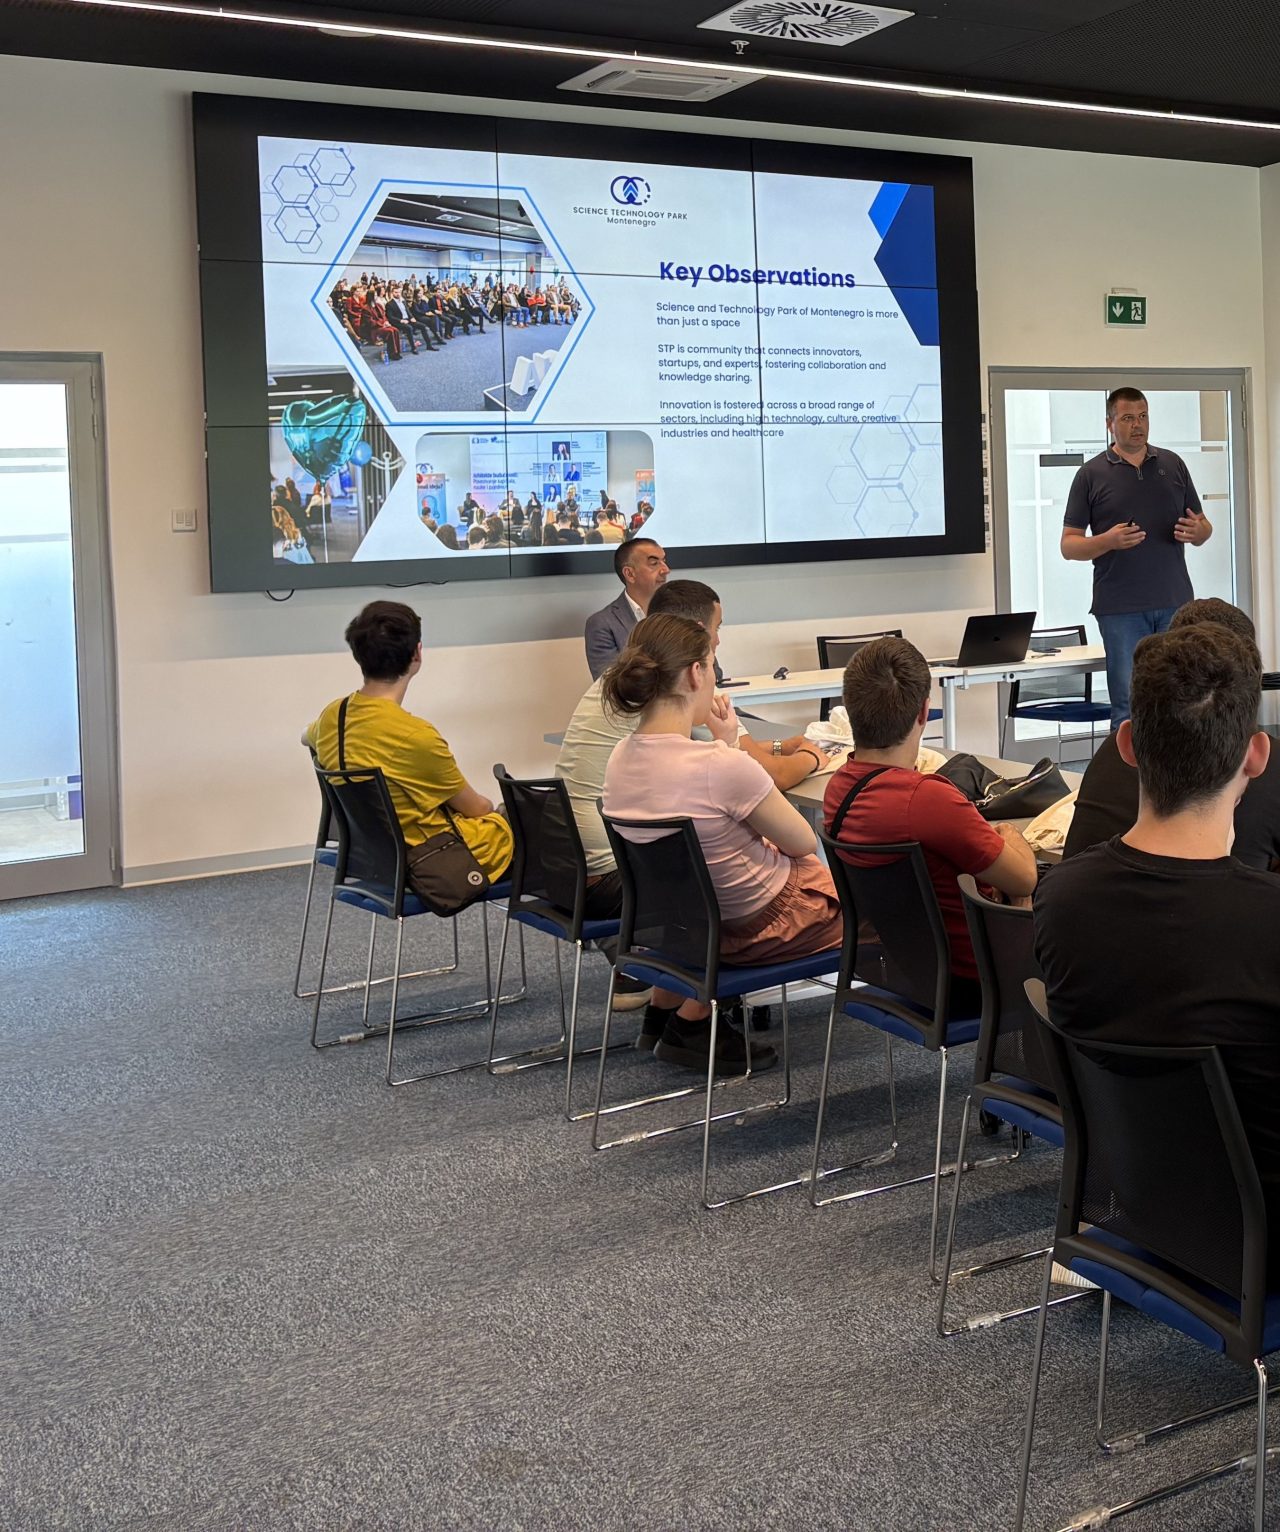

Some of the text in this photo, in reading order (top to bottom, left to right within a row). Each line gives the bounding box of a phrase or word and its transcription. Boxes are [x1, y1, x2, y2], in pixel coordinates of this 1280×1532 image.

[573, 206, 688, 220] SCIENCE TECHNOLOGY PARK
[607, 217, 656, 228] Montenegro
[660, 262, 856, 288] Key Observations
[656, 302, 899, 319] Science and Technology Park of Montenegro is more
[656, 316, 741, 329] than just a space
[658, 344, 862, 358] STP is community that connects innovators,
[658, 359, 887, 371] startups, and experts, fostering collaboration and
[659, 372, 753, 384] knowledge sharing.
[659, 400, 875, 412] Innovation is fostered across a broad range of
[660, 414, 897, 426] sectors, including high technology, culture, creative
[660, 428, 784, 438] industries and healthcare
